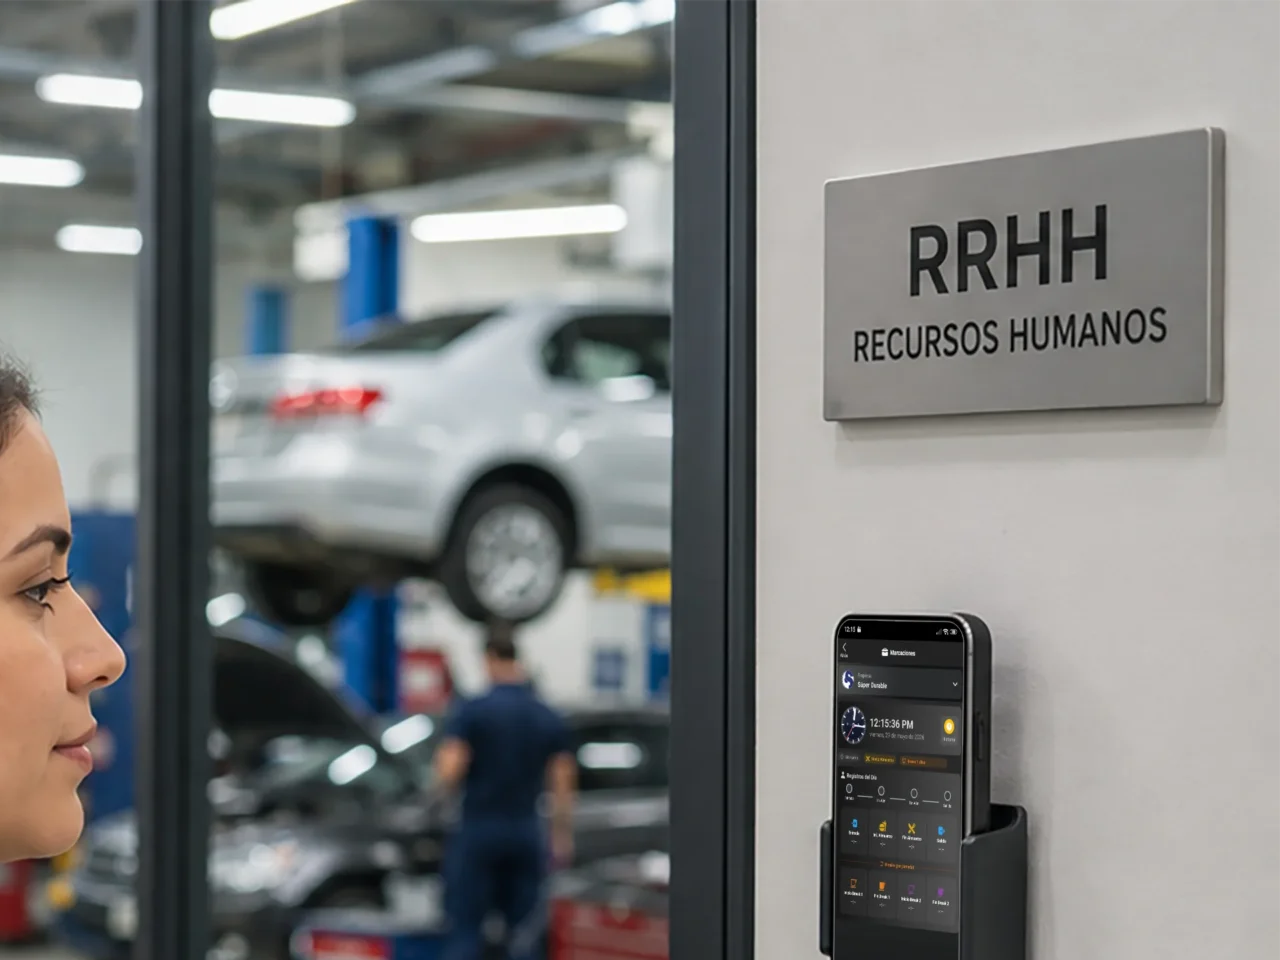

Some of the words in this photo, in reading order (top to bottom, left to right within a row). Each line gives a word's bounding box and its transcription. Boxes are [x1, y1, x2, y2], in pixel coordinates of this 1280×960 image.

[909, 203, 1107, 297] RRHH
[853, 319, 999, 363] RECURSOS
[1009, 306, 1168, 353] HUMANOS
[870, 718, 900, 729] 12:15:36
[901, 720, 914, 729] PM
